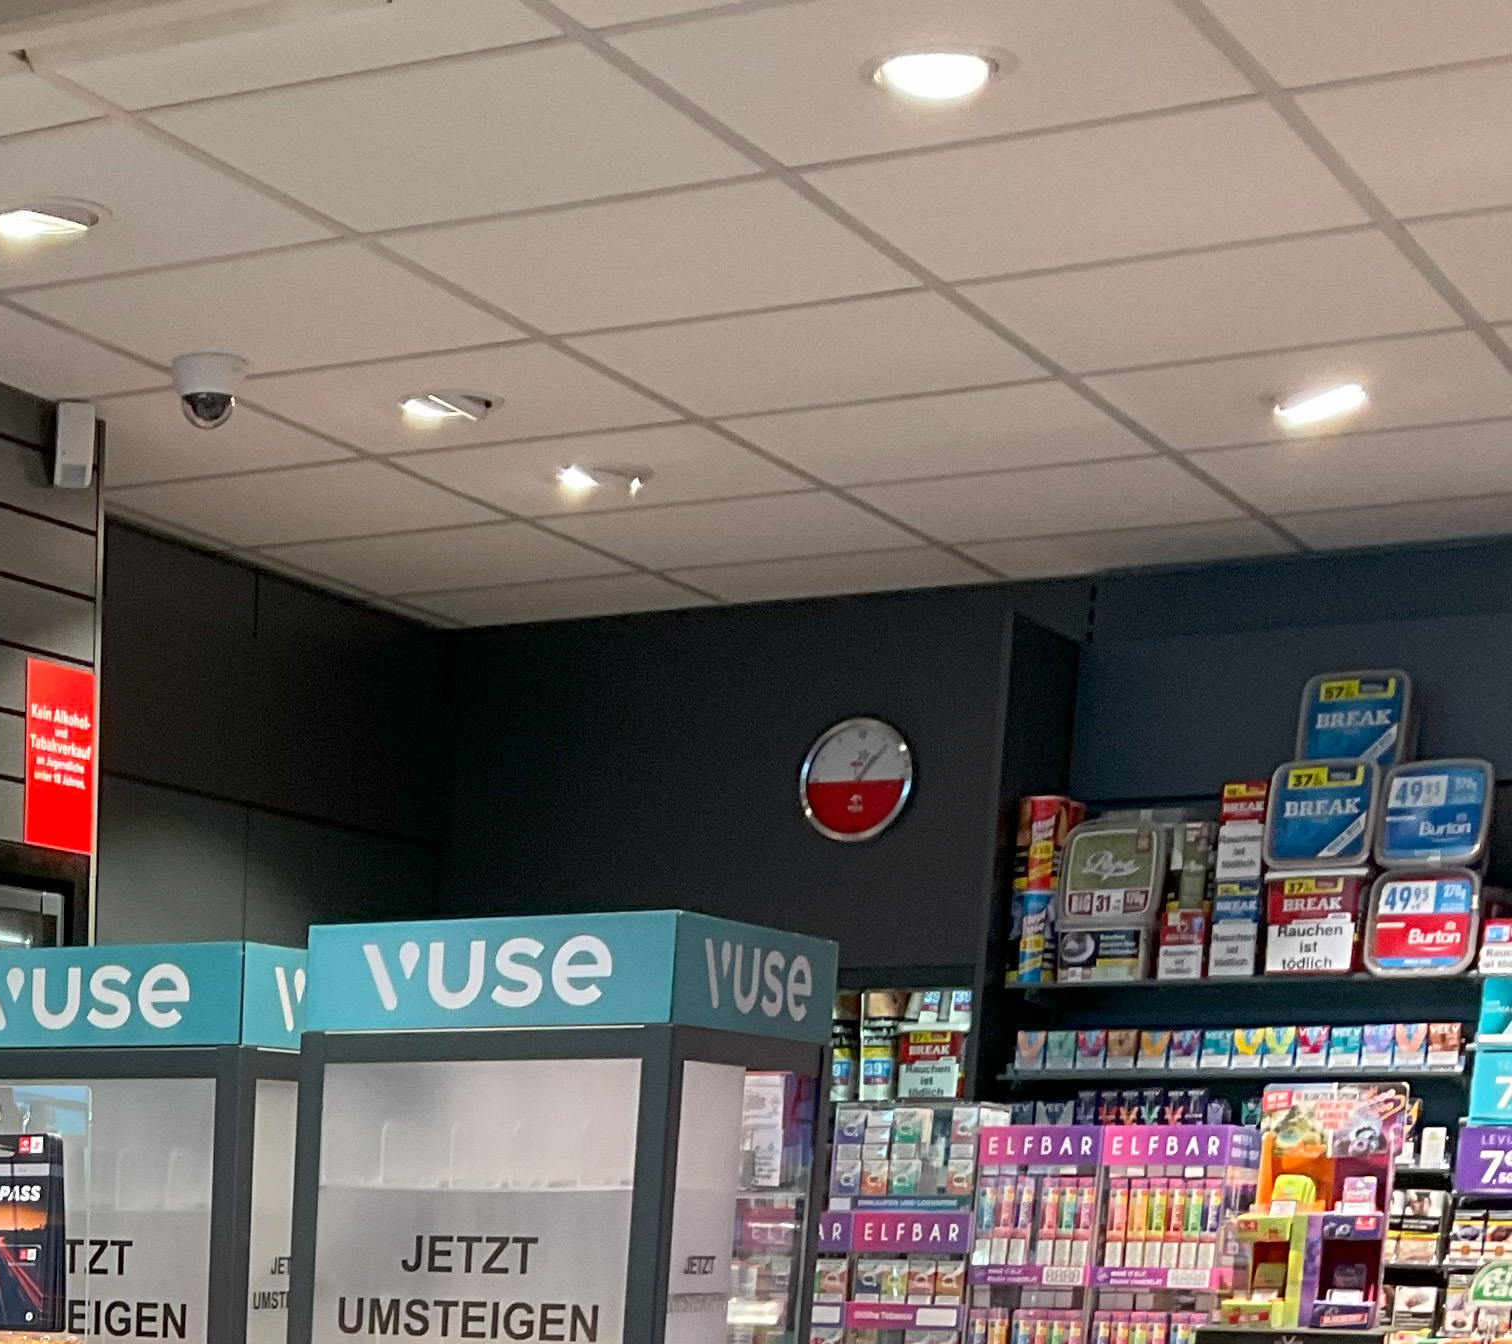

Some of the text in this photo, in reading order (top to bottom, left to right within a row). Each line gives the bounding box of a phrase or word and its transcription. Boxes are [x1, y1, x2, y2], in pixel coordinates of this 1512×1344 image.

[31, 702, 52, 721] Kein
[1315, 708, 1392, 730] BREAK
[29, 733, 92, 760] Tabakverkauf
[1222, 800, 1266, 813] BREAK
[1283, 797, 1361, 818] BREAK
[1418, 818, 1472, 837] Burton
[1282, 896, 1343, 913] BREAK
[1276, 923, 1344, 939] Rauchen
[1407, 927, 1462, 946] Burton
[1298, 940, 1318, 953] ist
[1281, 955, 1333, 971] tödlich
[908, 1043, 950, 1055] BREAK
[904, 1064, 952, 1075] Rauchen
[919, 1076, 933, 1086] ist
[908, 1087, 944, 1098] tödlich
[987, 1135, 1093, 1157] ELFBAR
[1111, 1135, 1221, 1157] ELFBAR
[863, 1222, 960, 1242] ELFBAR
[401, 1235, 539, 1275] JETZT
[683, 1255, 717, 1276] JETZT
[68, 1300, 188, 1340] EIGEN
[338, 1296, 600, 1343] UMSTEIGEN
